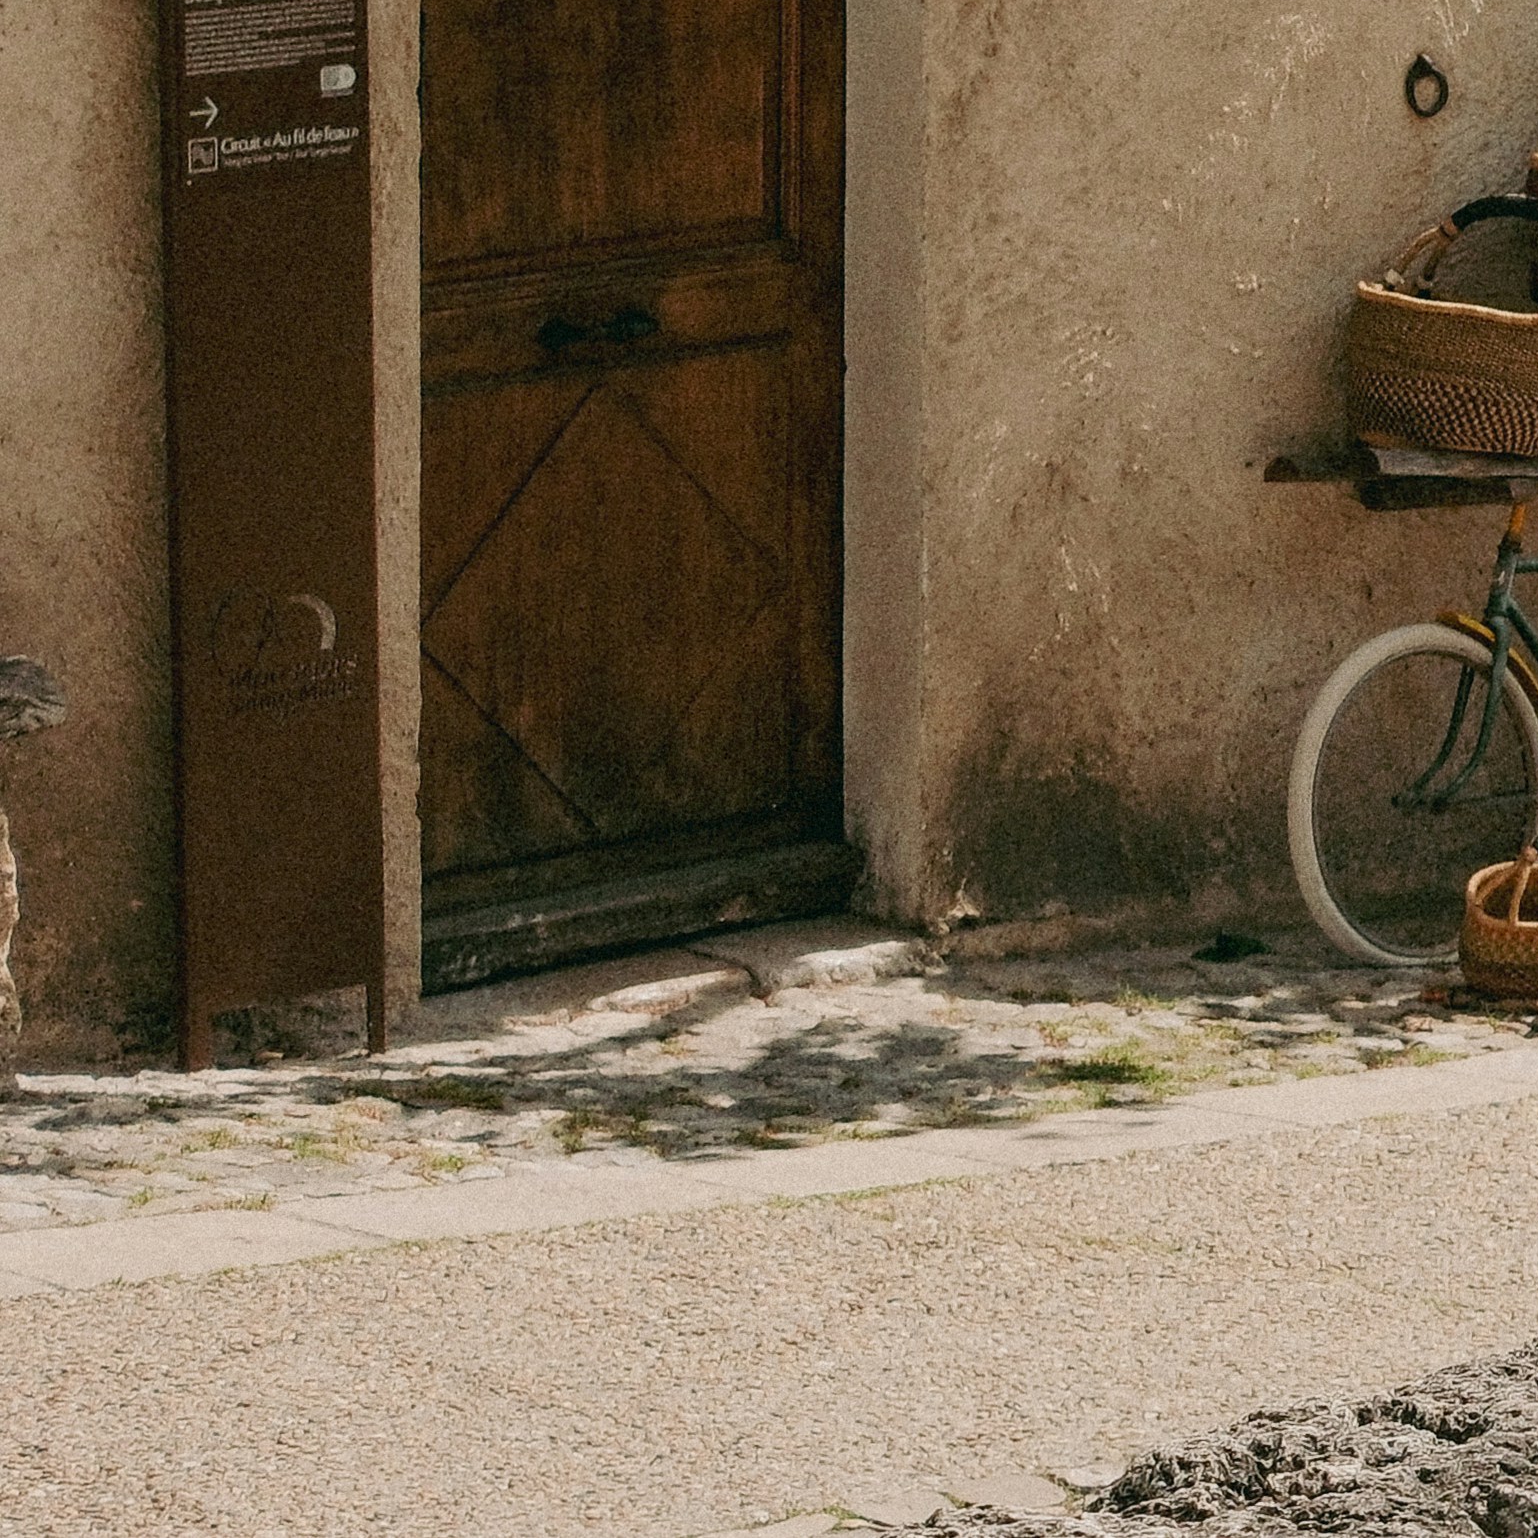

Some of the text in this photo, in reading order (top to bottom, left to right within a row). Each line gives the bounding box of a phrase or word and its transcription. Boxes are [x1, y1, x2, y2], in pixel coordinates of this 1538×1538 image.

[221, 135, 263, 155] Circuit
[273, 131, 292, 147] Au
[293, 128, 306, 144] fil
[307, 127, 323, 144] de
